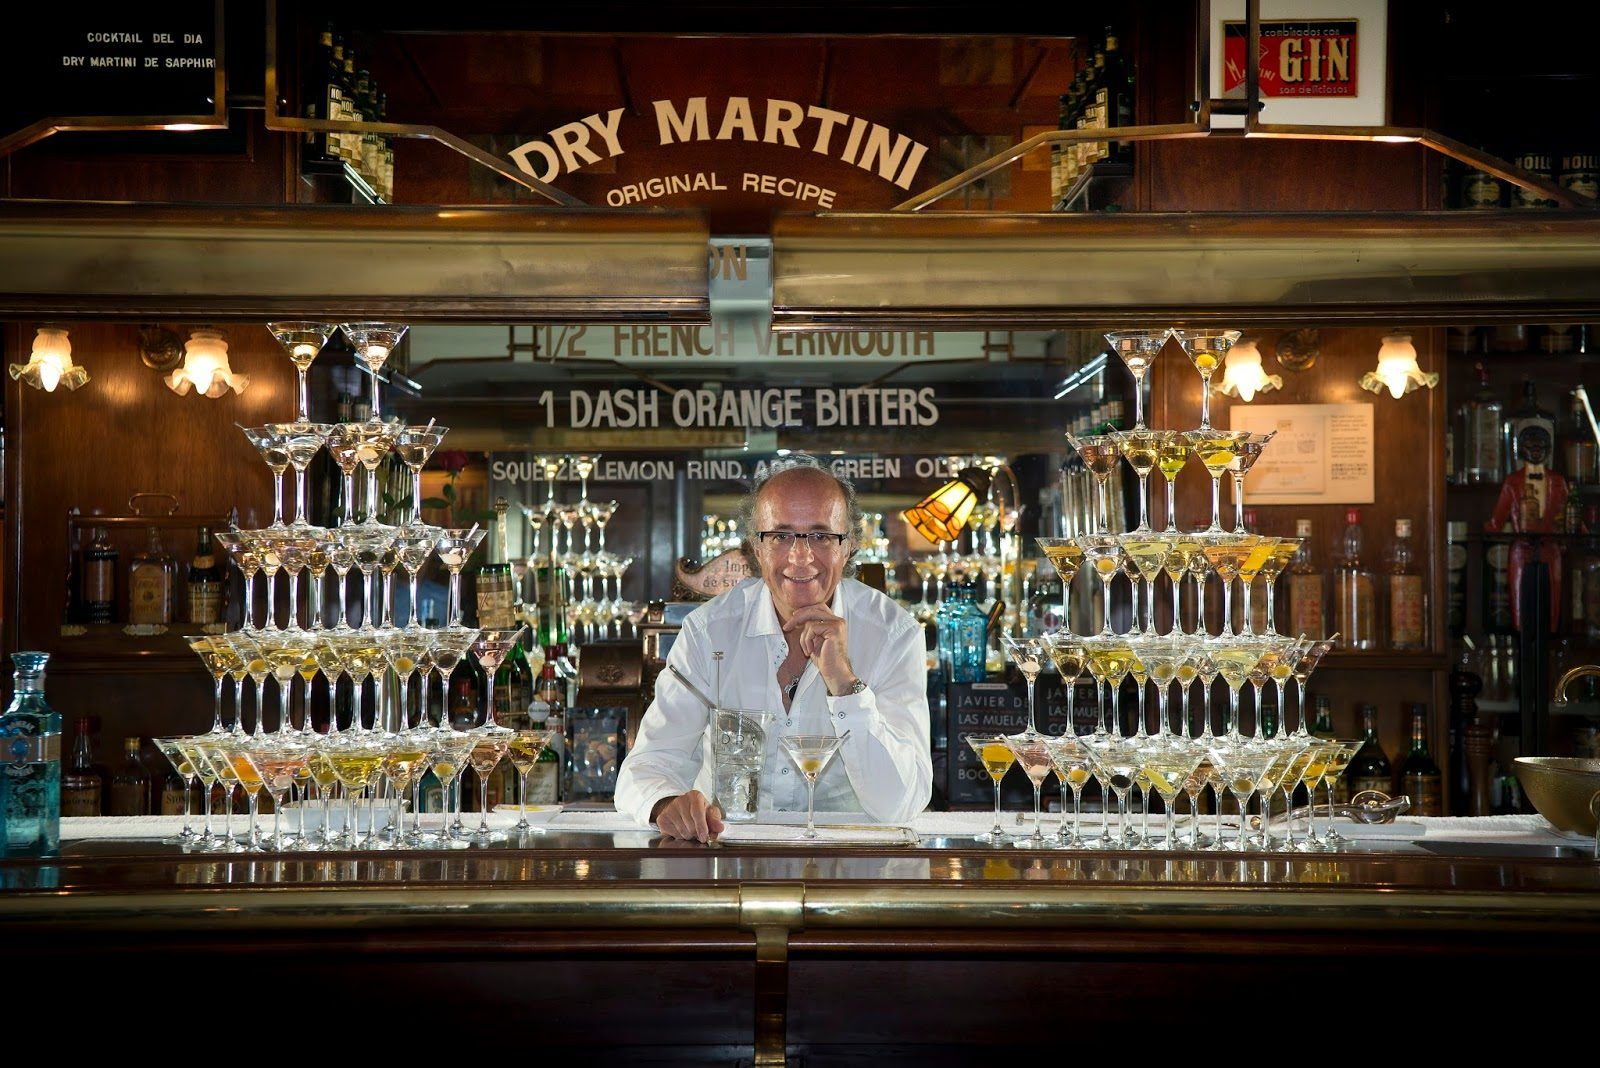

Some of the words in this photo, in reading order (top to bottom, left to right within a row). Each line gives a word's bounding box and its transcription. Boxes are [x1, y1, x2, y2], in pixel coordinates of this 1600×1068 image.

[87, 32, 143, 43] COCKTAIL
[153, 33, 174, 44] DEL
[184, 33, 203, 44] DIA
[63, 55, 85, 66] DRY
[90, 56, 137, 67] MARTINI
[144, 57, 159, 68] DE
[508, 107, 626, 192] DRY
[652, 96, 929, 190] MARTINI
[606, 173, 728, 207] ORIGINAL
[742, 173, 837, 209] RECIPE
[614, 317, 735, 356] FRENCH
[752, 317, 935, 356] VERMOUTH
[538, 389, 554, 427] 1
[570, 388, 659, 428] DASH
[672, 388, 803, 428] ORANGE
[815, 386, 940, 427] BITTERS
[593, 460, 674, 481] LEMON
[687, 460, 748, 480] RIND.
[831, 458, 901, 479] GREEN
[956, 695, 1006, 708] JAVIER
[958, 714, 979, 725] LAS
[958, 768, 992, 780] BOO
